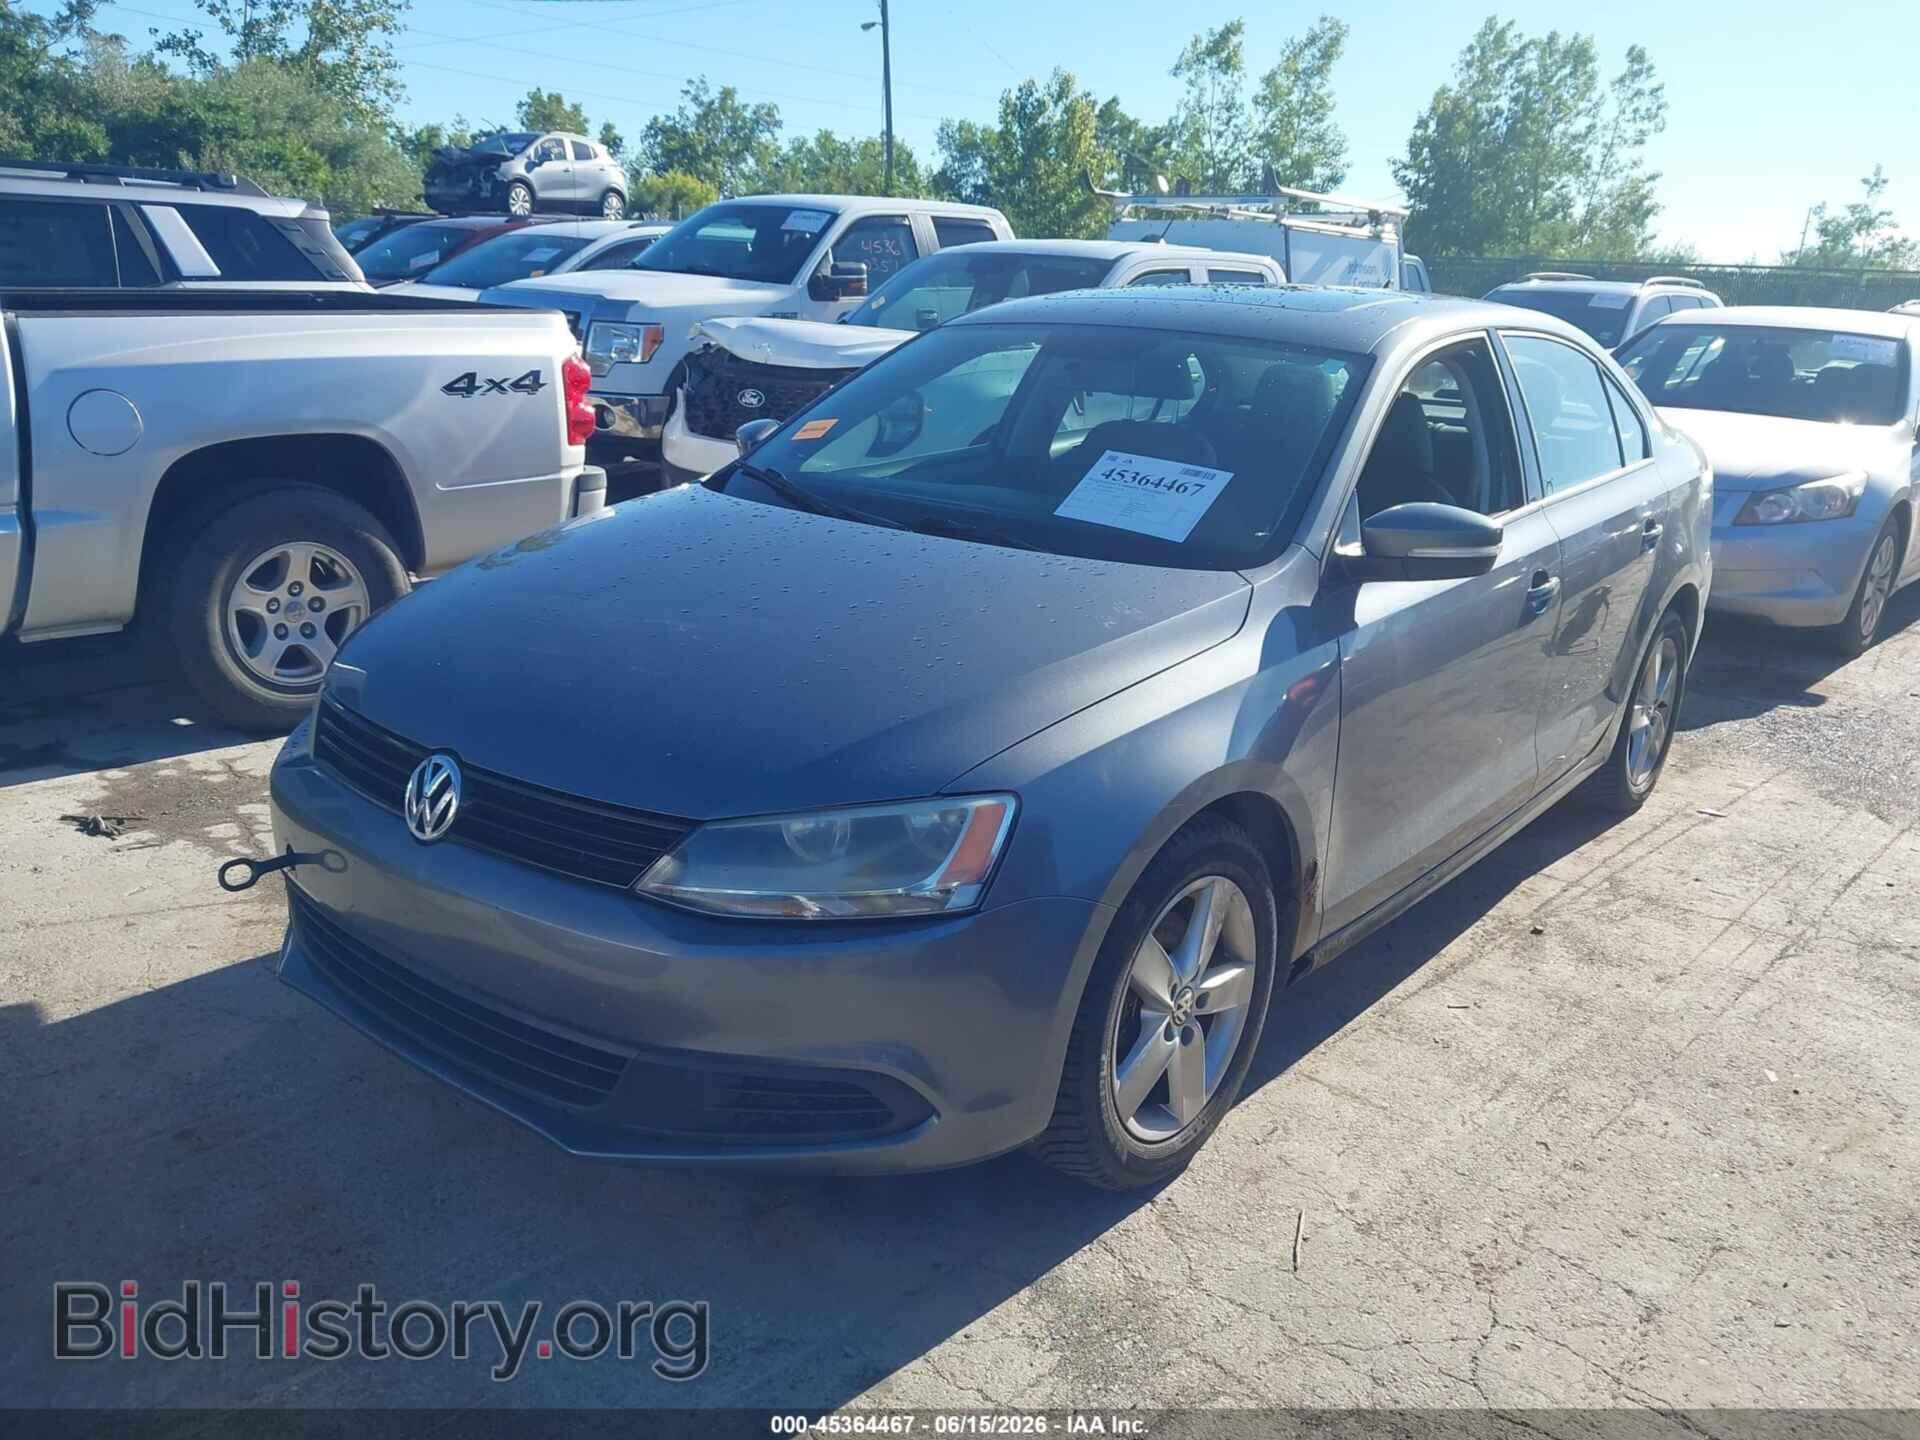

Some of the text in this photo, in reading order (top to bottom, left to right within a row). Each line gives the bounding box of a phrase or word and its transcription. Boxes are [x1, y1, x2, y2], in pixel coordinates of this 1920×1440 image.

[440, 369, 549, 399] 4x4
[739, 389, 763, 406] Ford
[1100, 466, 1206, 497] 45364467
